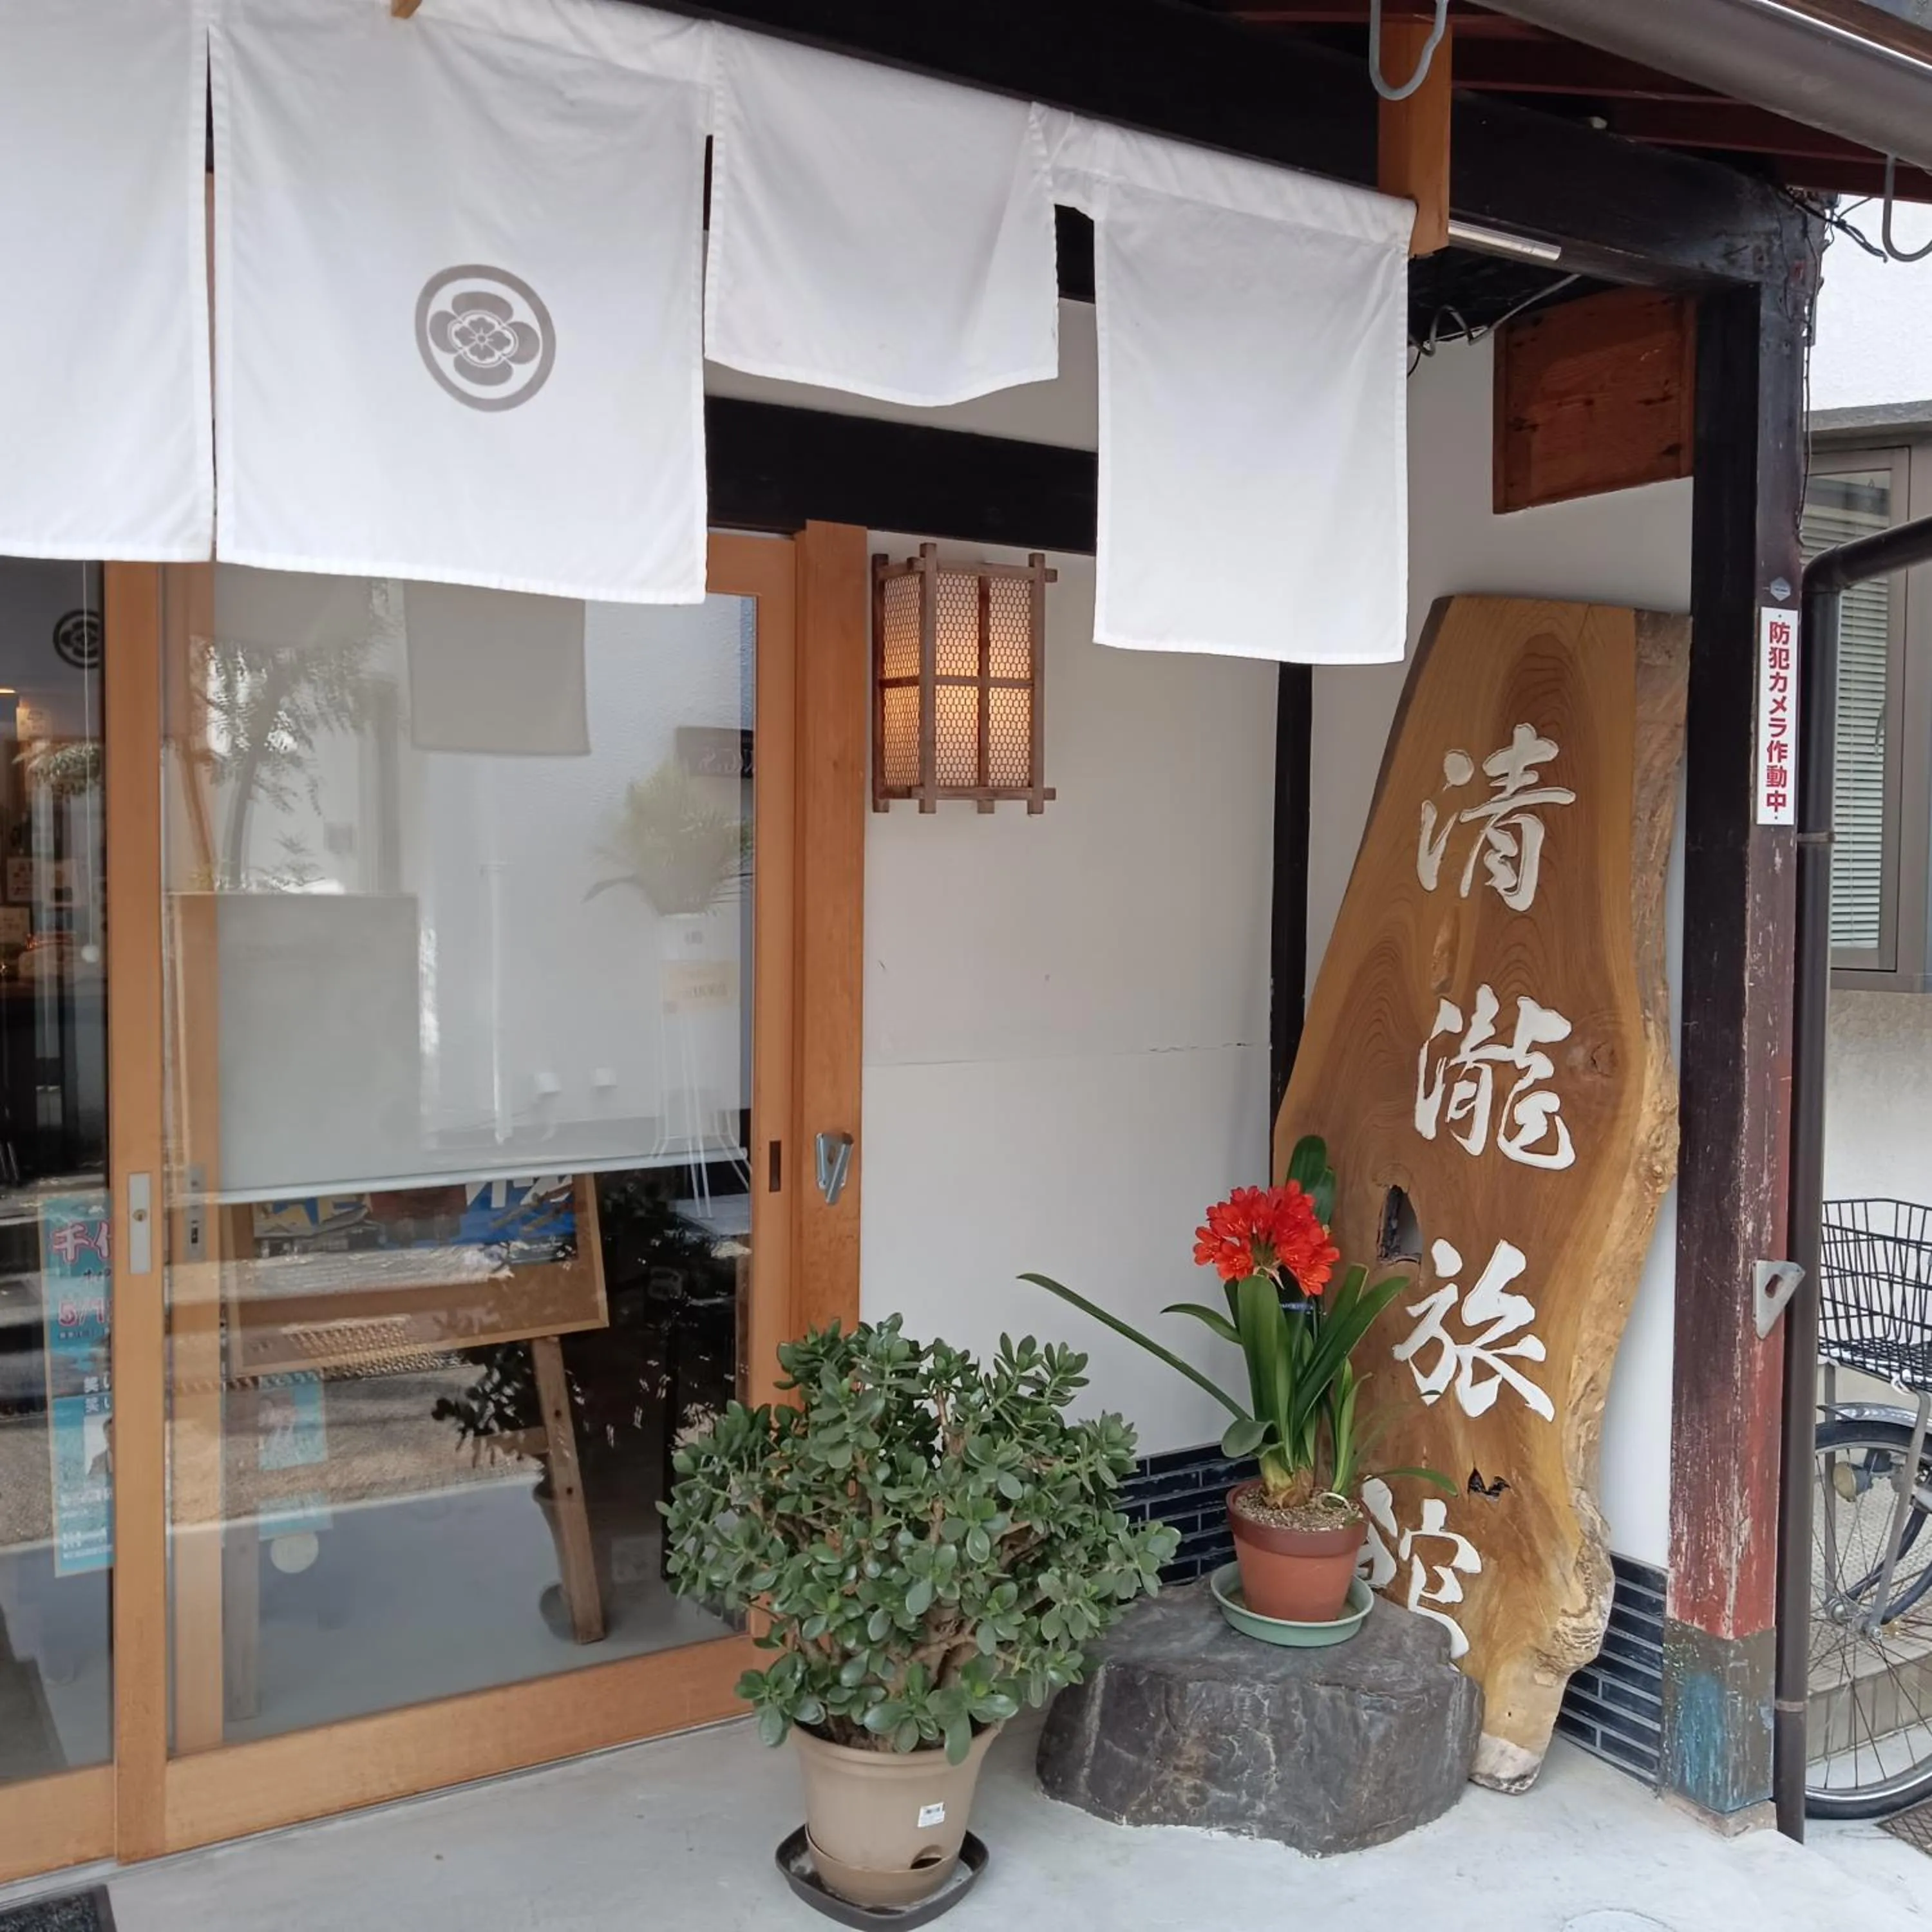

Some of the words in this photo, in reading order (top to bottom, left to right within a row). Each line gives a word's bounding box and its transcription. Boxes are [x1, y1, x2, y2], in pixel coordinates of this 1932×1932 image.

[1765, 621, 1791, 812] 防犯カメラ作動中
